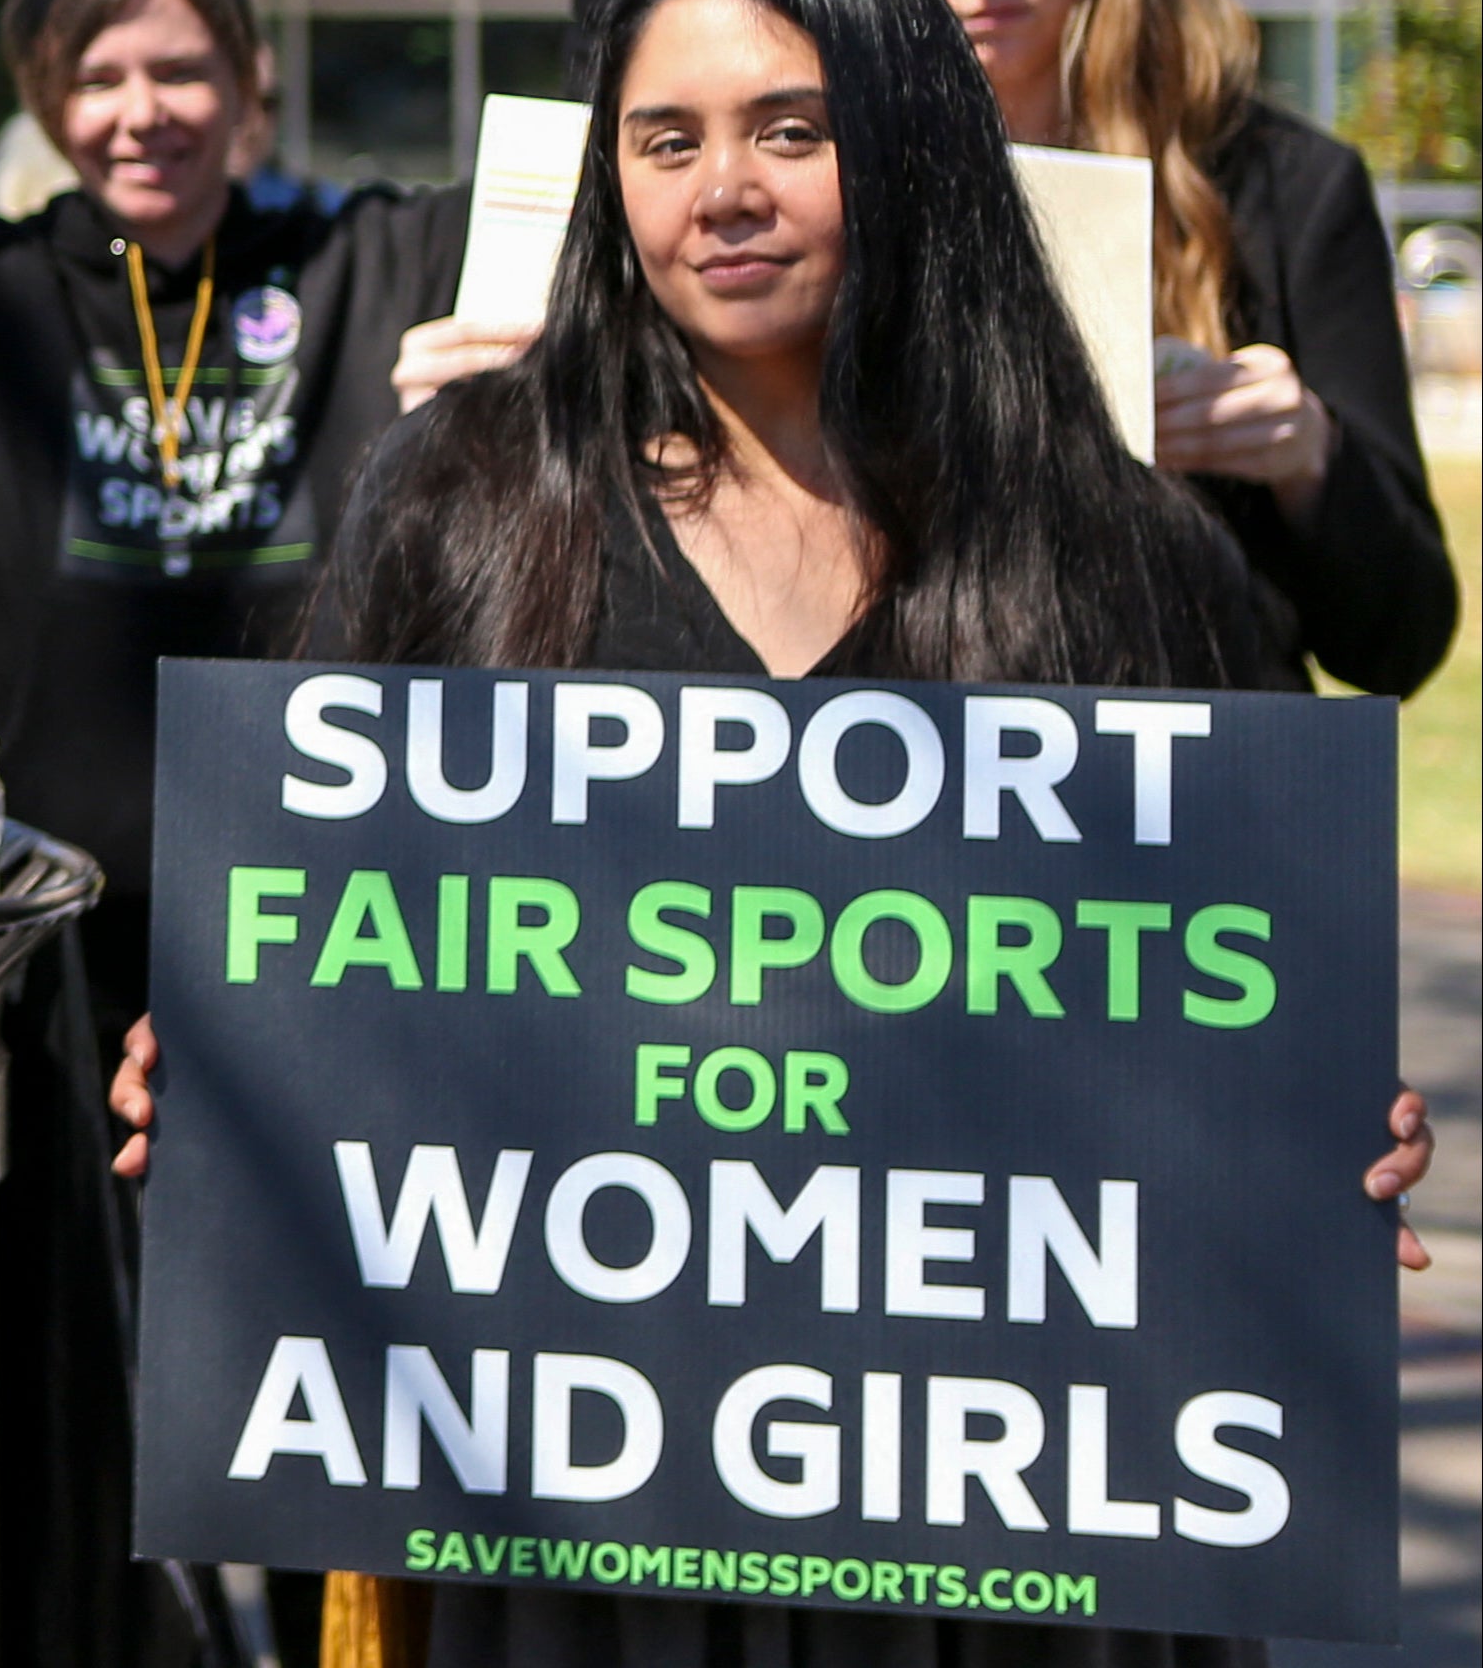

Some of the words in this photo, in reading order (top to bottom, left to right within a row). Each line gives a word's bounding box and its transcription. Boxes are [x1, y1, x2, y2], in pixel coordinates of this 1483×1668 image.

[282, 674, 1212, 845] SUPPORT
[226, 867, 581, 997] FAIR
[625, 881, 1277, 1029] SPORTS
[635, 1044, 849, 1135] FOR
[334, 1141, 1137, 1328] WOMEN
[229, 1336, 663, 1501] AND
[711, 1365, 1291, 1548] GIRLS
[406, 1530, 1097, 1615] SAVEWOMENSSPORTS.COM
